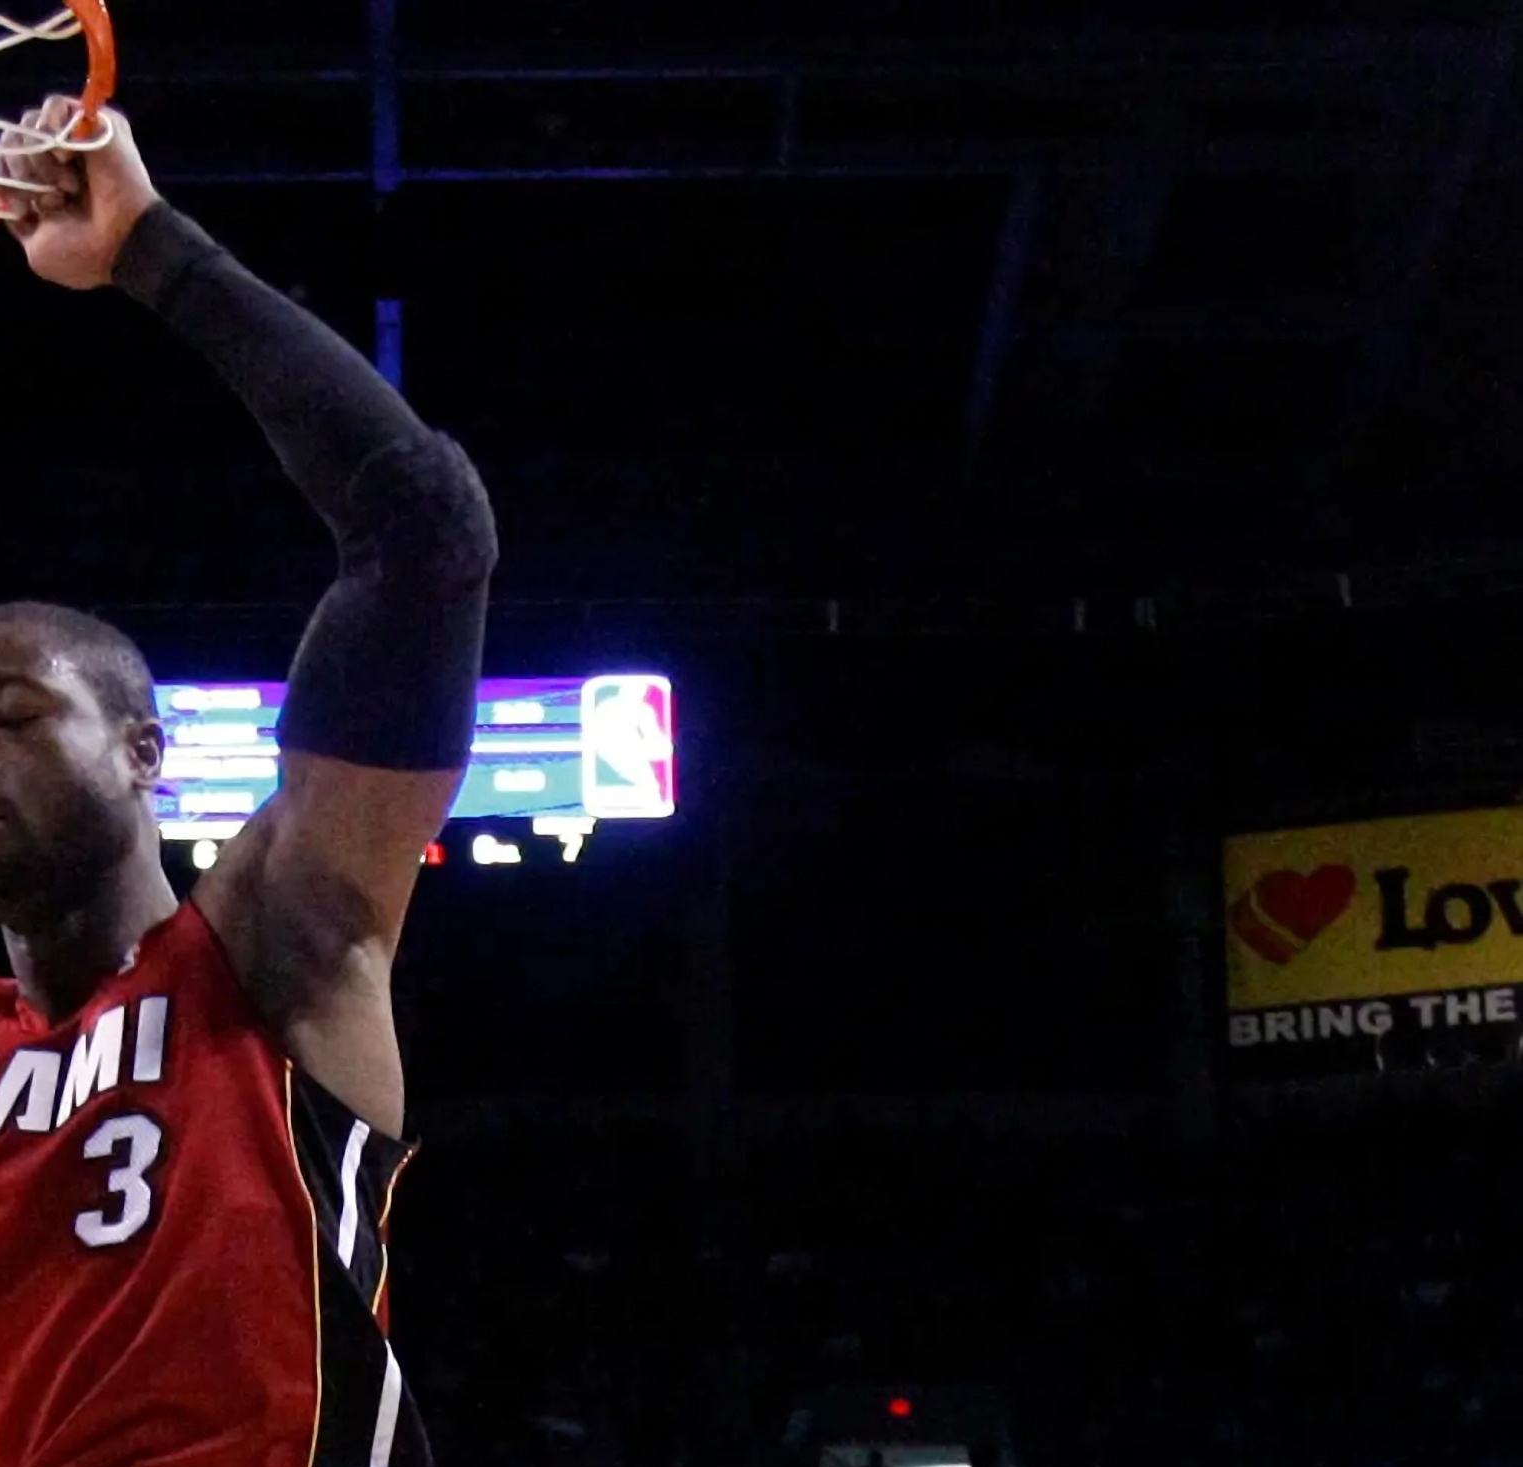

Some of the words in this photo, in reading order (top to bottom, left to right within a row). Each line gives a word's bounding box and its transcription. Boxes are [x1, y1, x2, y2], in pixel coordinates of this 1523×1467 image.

[1228, 1001, 1393, 1047] BRING
[1409, 988, 1517, 1029] THE
[74, 1113, 162, 1248] 3
